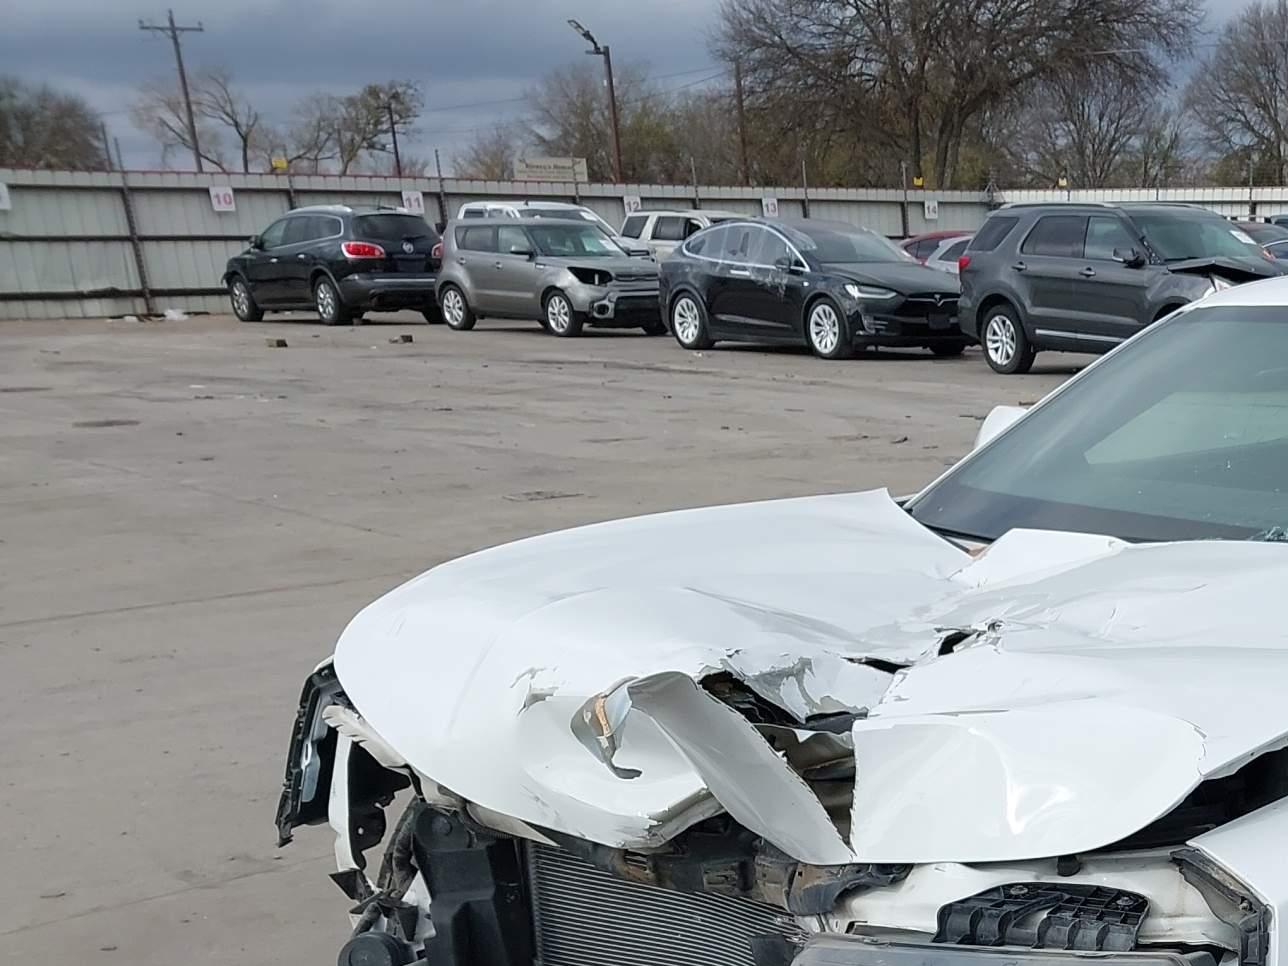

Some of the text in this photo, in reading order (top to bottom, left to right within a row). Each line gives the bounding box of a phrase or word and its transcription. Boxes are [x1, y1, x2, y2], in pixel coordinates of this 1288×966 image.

[213, 192, 233, 206] 10
[405, 196, 421, 209] 11
[625, 201, 640, 212] 12
[764, 202, 777, 214] 13
